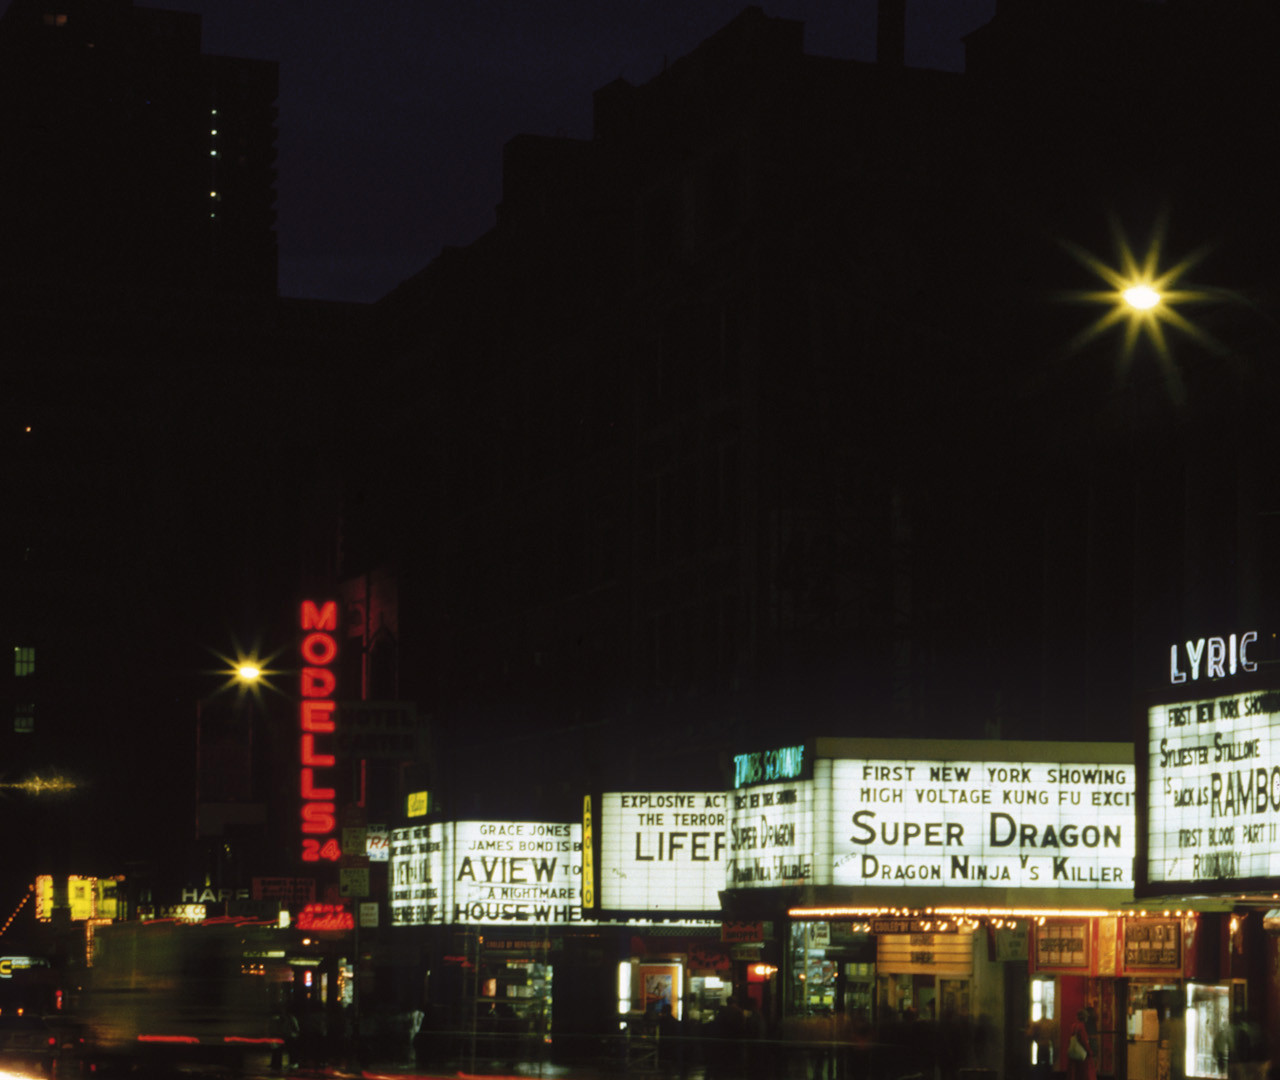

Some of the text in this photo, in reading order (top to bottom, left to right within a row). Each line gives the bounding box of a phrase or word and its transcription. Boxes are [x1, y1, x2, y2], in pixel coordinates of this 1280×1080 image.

[1170, 631, 1258, 684] LYRIC
[300, 601, 340, 834] MODELLS
[1168, 707, 1191, 728] FIRST
[1197, 703, 1214, 723] NEW
[1220, 699, 1240, 720] YORK
[1160, 732, 1260, 768] SYLVESTER STALLONE
[863, 766, 1126, 785] FIRST NEW YORK SHOWING
[621, 795, 695, 808] EXPLOSIVE
[861, 788, 1081, 806] HIGH VOLTAGE KUNG FU
[1174, 787, 1194, 807] BACK
[1197, 786, 1208, 806] AS
[480, 825, 571, 836] GRACE JONES
[638, 814, 725, 826] THE TERROR
[851, 810, 1121, 848] SUPER DRAGON
[468, 840, 570, 851] JAMES BOND IS
[1179, 828, 1202, 848] FIRST
[1208, 825, 1234, 846] BLOOD
[1243, 823, 1265, 844] PART
[301, 838, 341, 862] 24
[457, 856, 475, 882] A
[481, 857, 557, 883] VIEW
[562, 865, 581, 875] TO
[861, 855, 1122, 882] DRAGON NINJA KILLER
[487, 888, 575, 899] A NIGHTMARE
[455, 903, 530, 921] HOUSE
